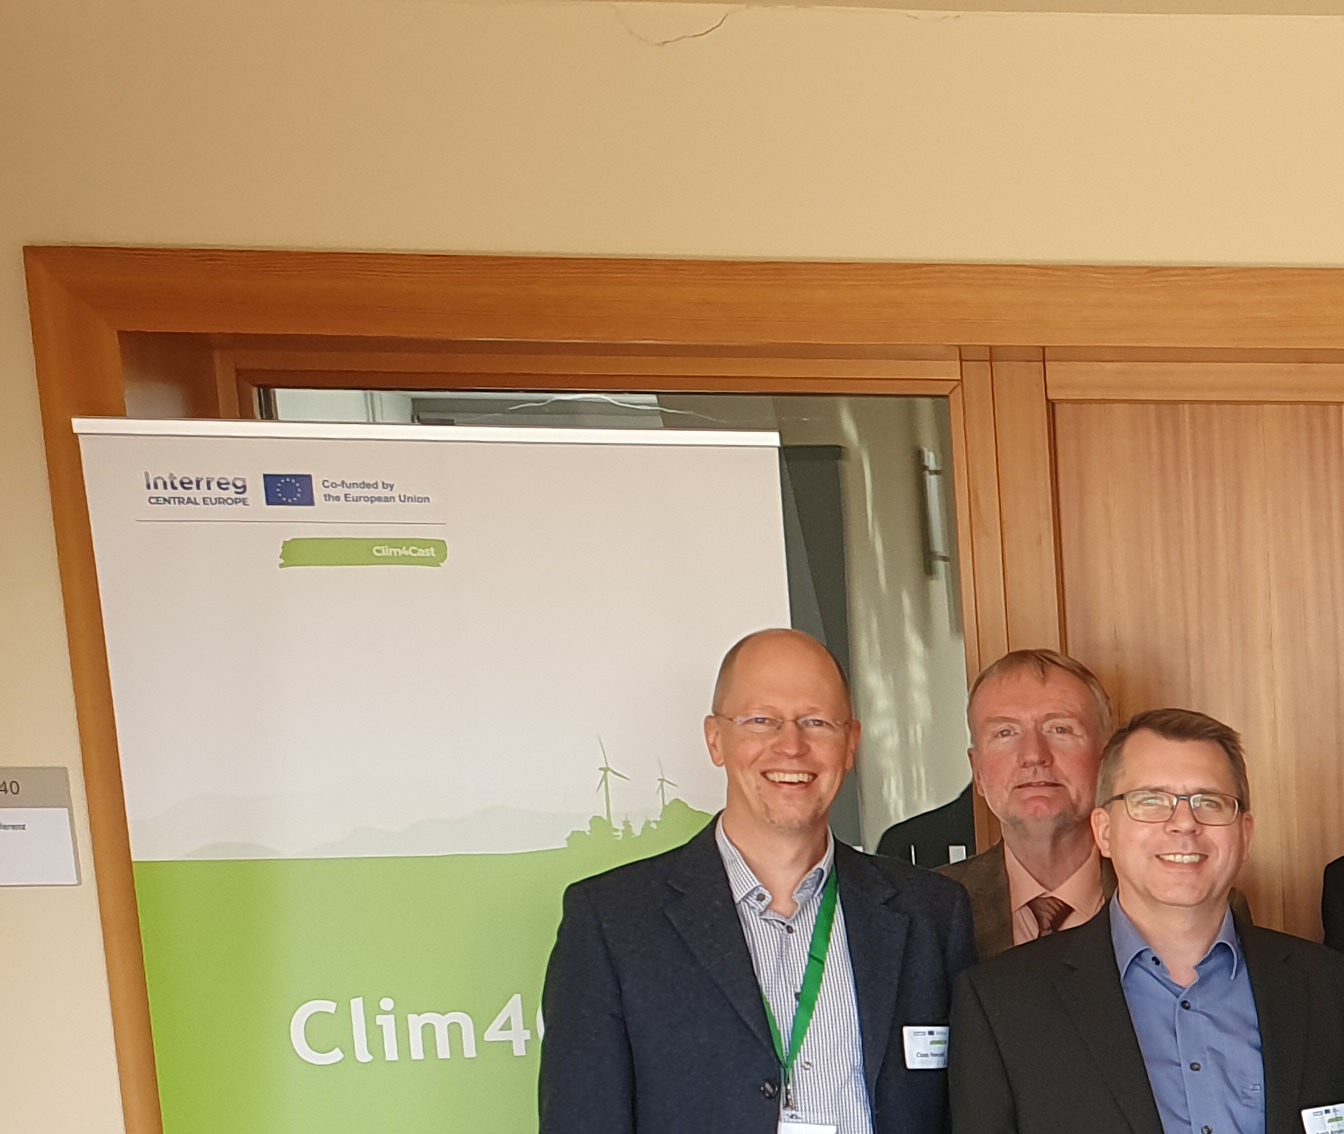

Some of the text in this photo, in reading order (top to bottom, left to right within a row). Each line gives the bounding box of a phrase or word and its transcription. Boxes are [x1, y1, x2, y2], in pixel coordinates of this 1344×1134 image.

[144, 471, 248, 494] Interreg
[322, 480, 394, 492] Co-funded by
[148, 496, 250, 506] CENTRAL EUROPE
[324, 493, 430, 504] the European Union
[372, 546, 436, 557] Clim4Cast
